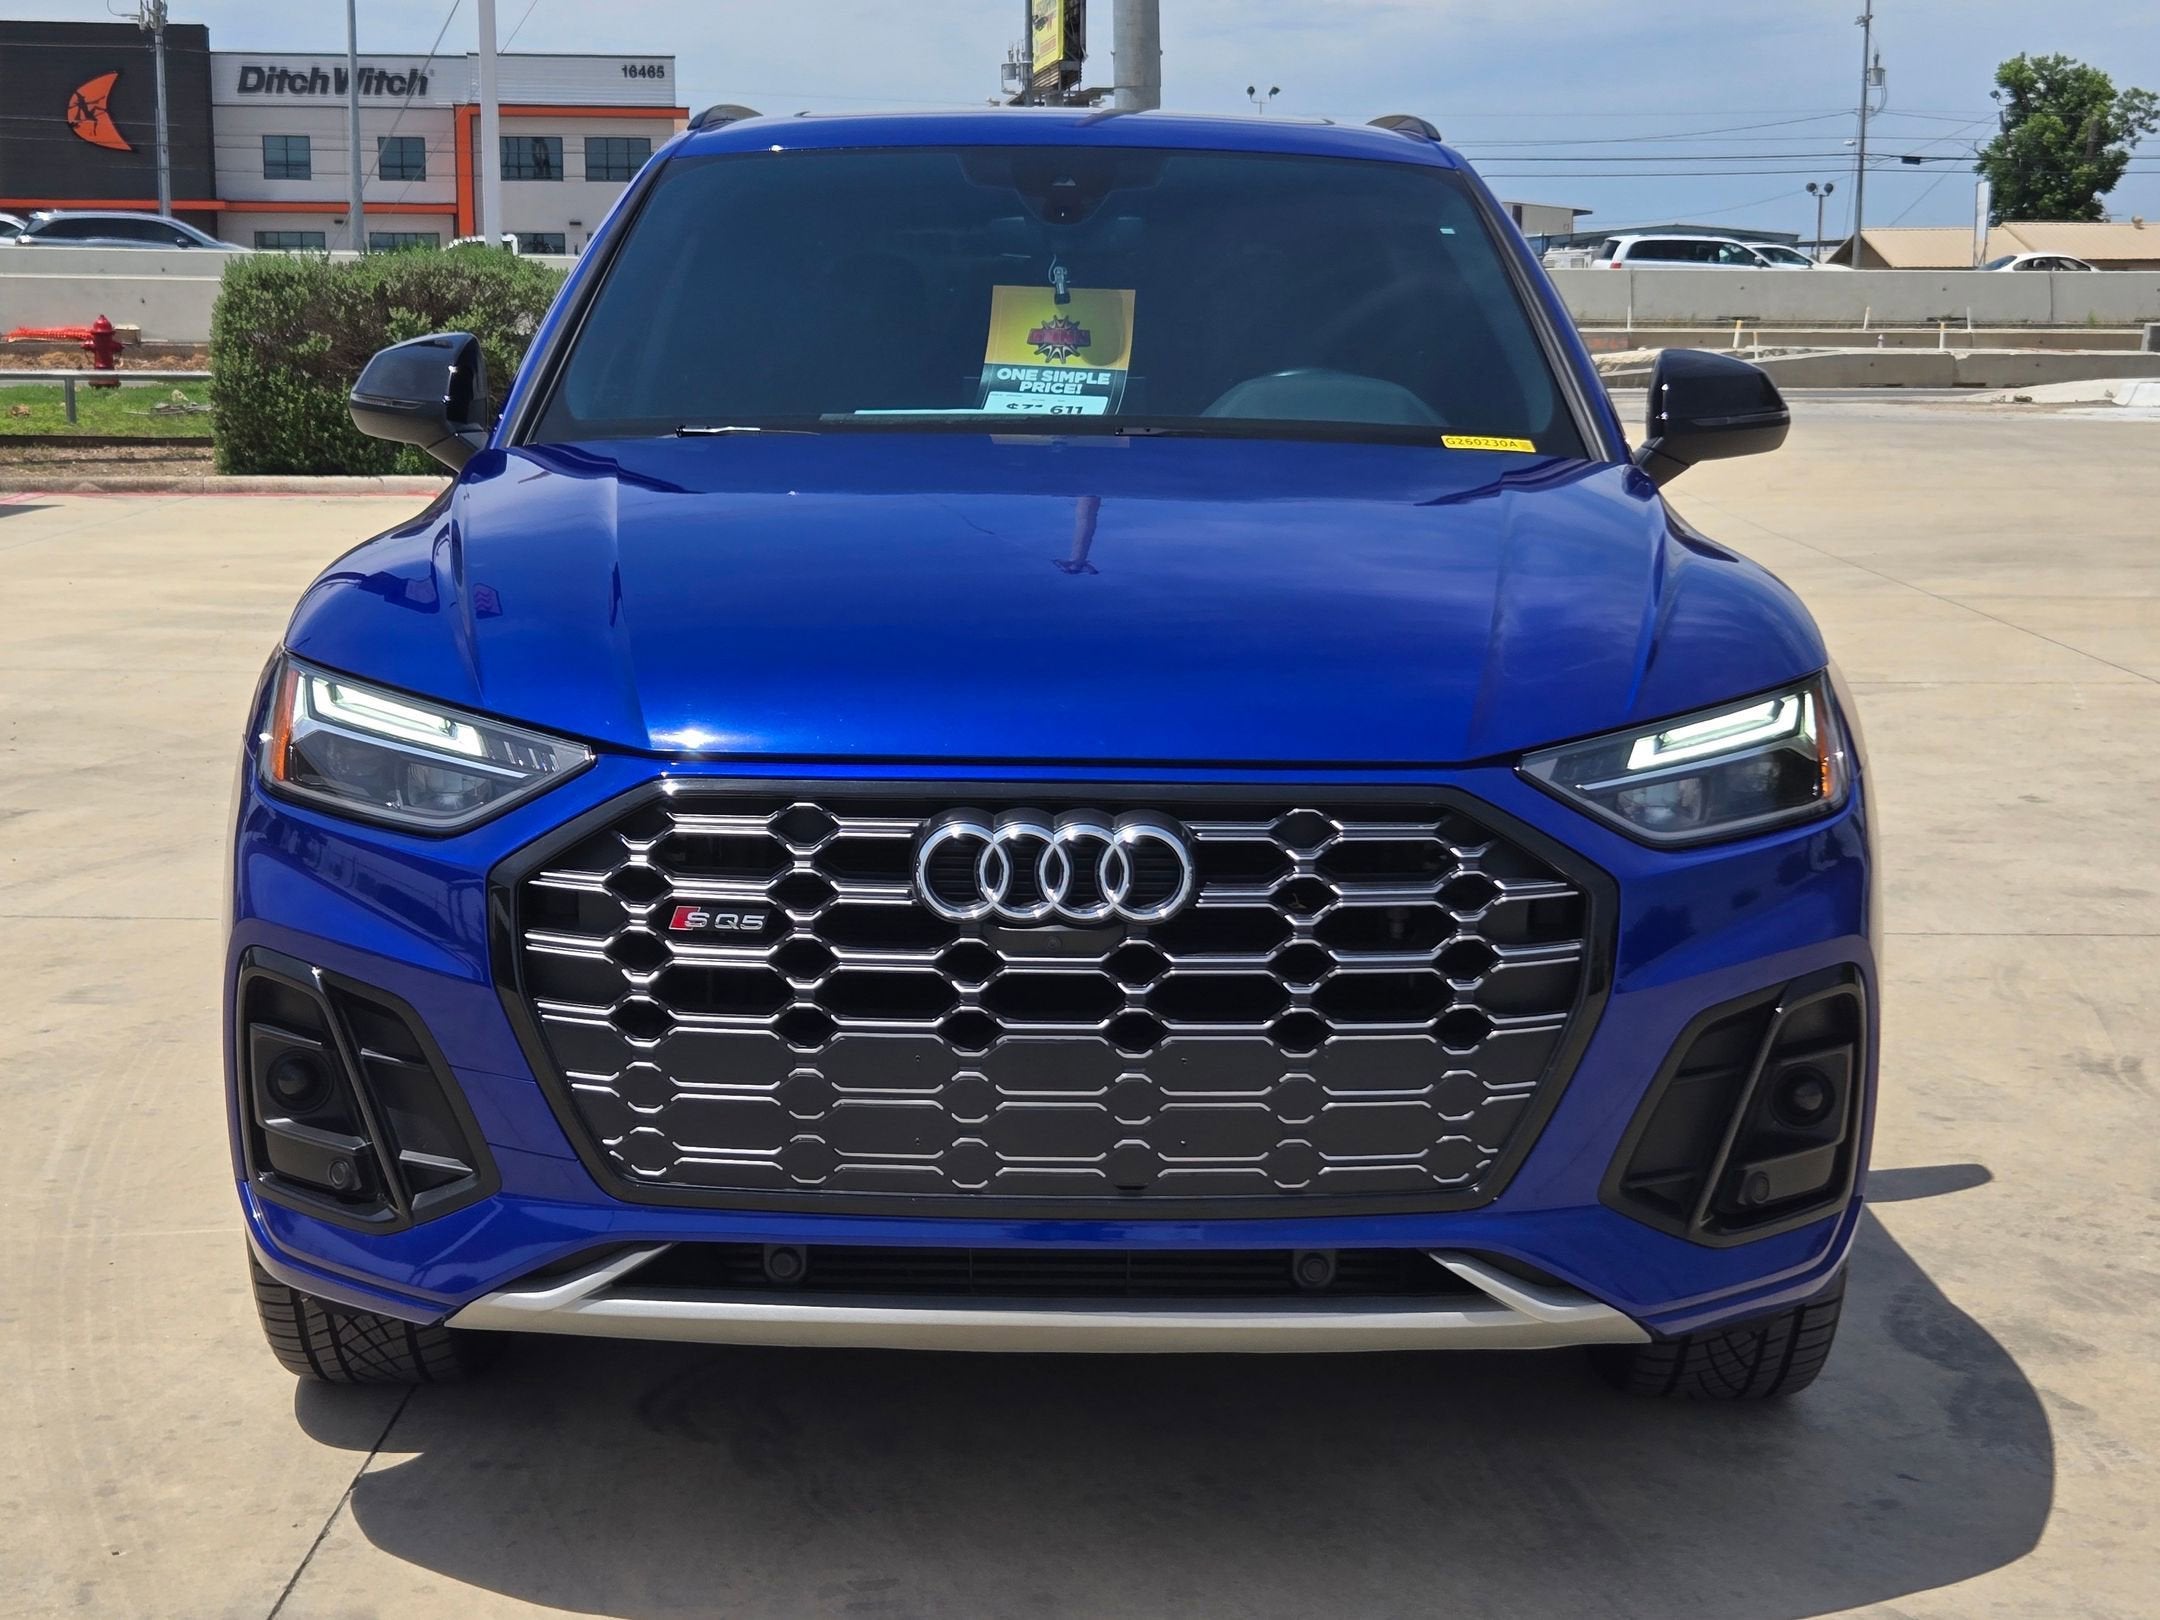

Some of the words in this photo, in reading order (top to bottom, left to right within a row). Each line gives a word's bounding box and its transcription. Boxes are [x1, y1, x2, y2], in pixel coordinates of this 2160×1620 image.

[621, 64, 665, 79] 16465
[237, 66, 330, 94] Ditch
[334, 67, 428, 95] Witch
[996, 367, 1039, 381] ONE
[1041, 370, 1112, 385] SIMPLE
[1019, 381, 1083, 394] PRICE!
[1445, 437, 1519, 448] G260230A
[684, 912, 765, 930] SQ5
